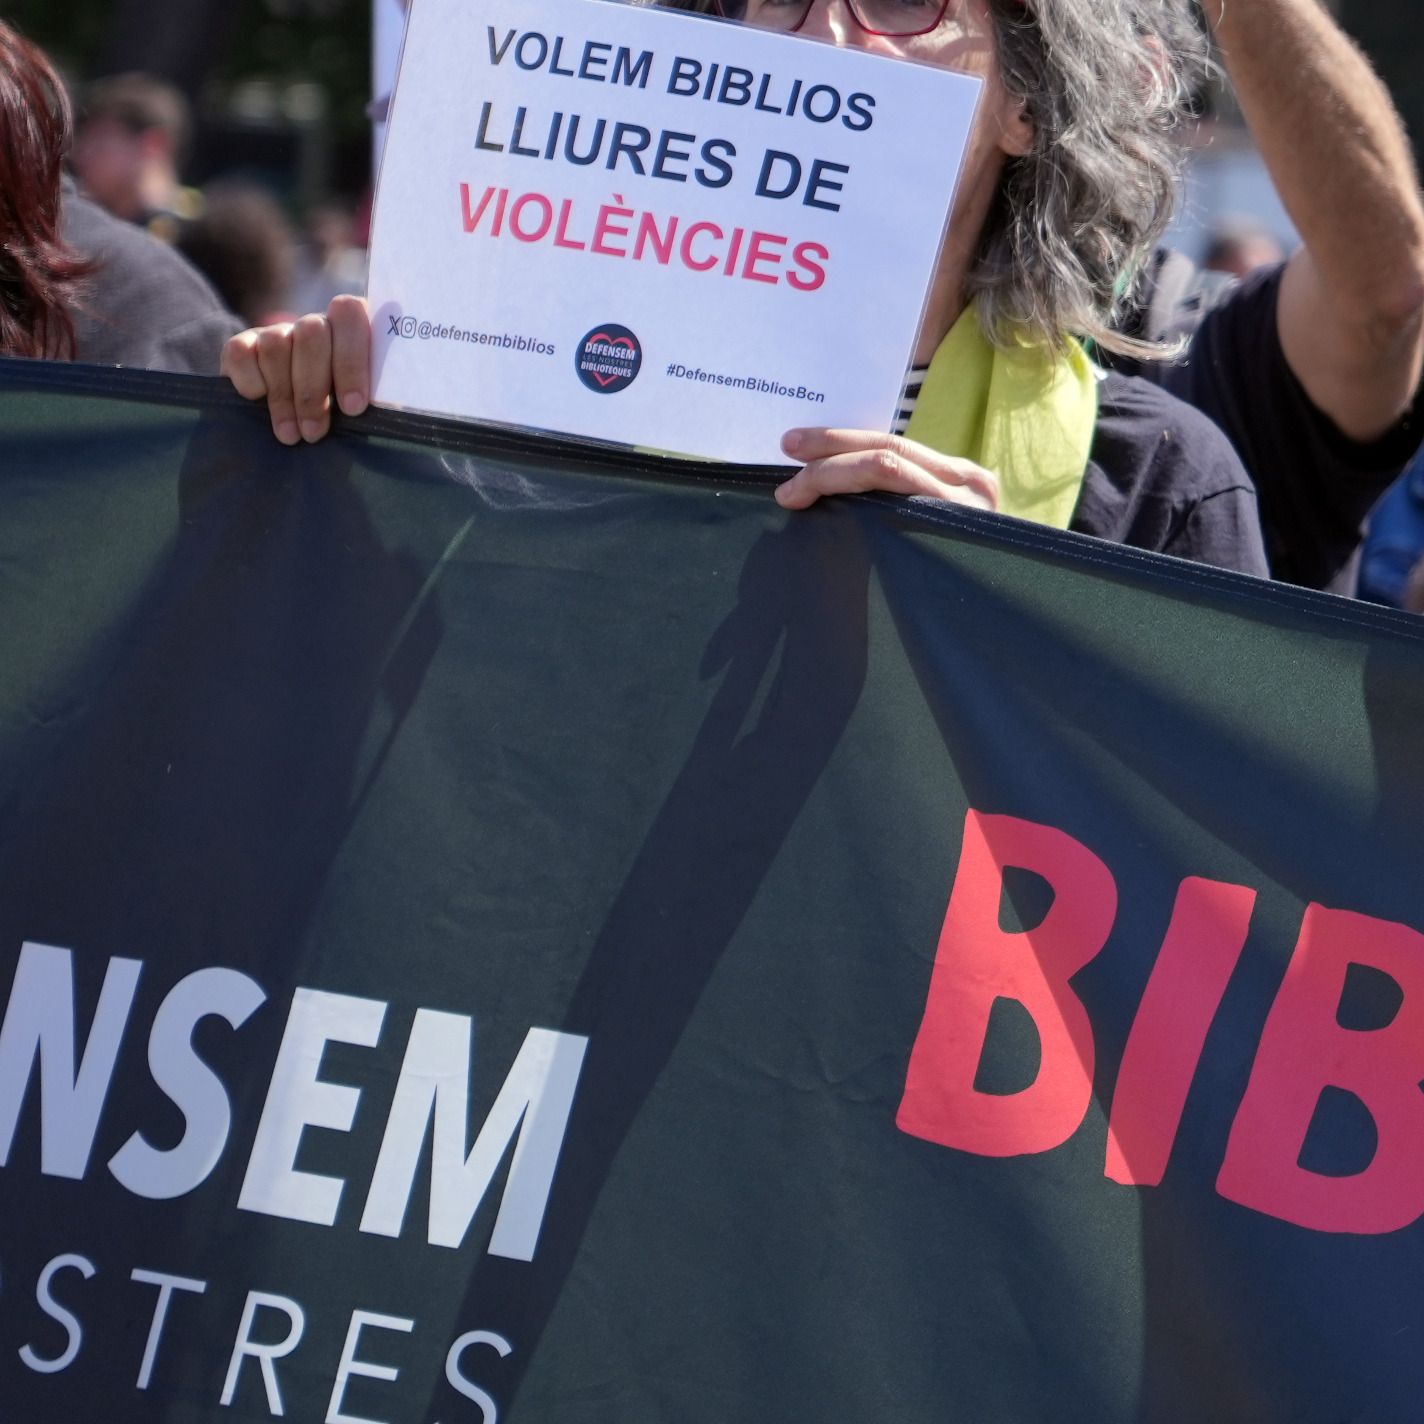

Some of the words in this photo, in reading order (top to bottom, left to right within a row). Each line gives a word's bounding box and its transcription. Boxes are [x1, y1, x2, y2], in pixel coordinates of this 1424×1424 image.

[487, 26, 655, 88] VOLEM
[667, 56, 877, 132] BIBLIOS
[474, 102, 738, 189] LLIURES
[755, 149, 850, 212] DE
[458, 181, 831, 292] VIOLÈNCIES
[417, 321, 556, 357] @defensembiblios
[585, 342, 636, 361] DEFENSEM
[581, 361, 632, 378] BIBLIOTEQUES
[666, 362, 826, 404] #DefensemBibliosBcn
